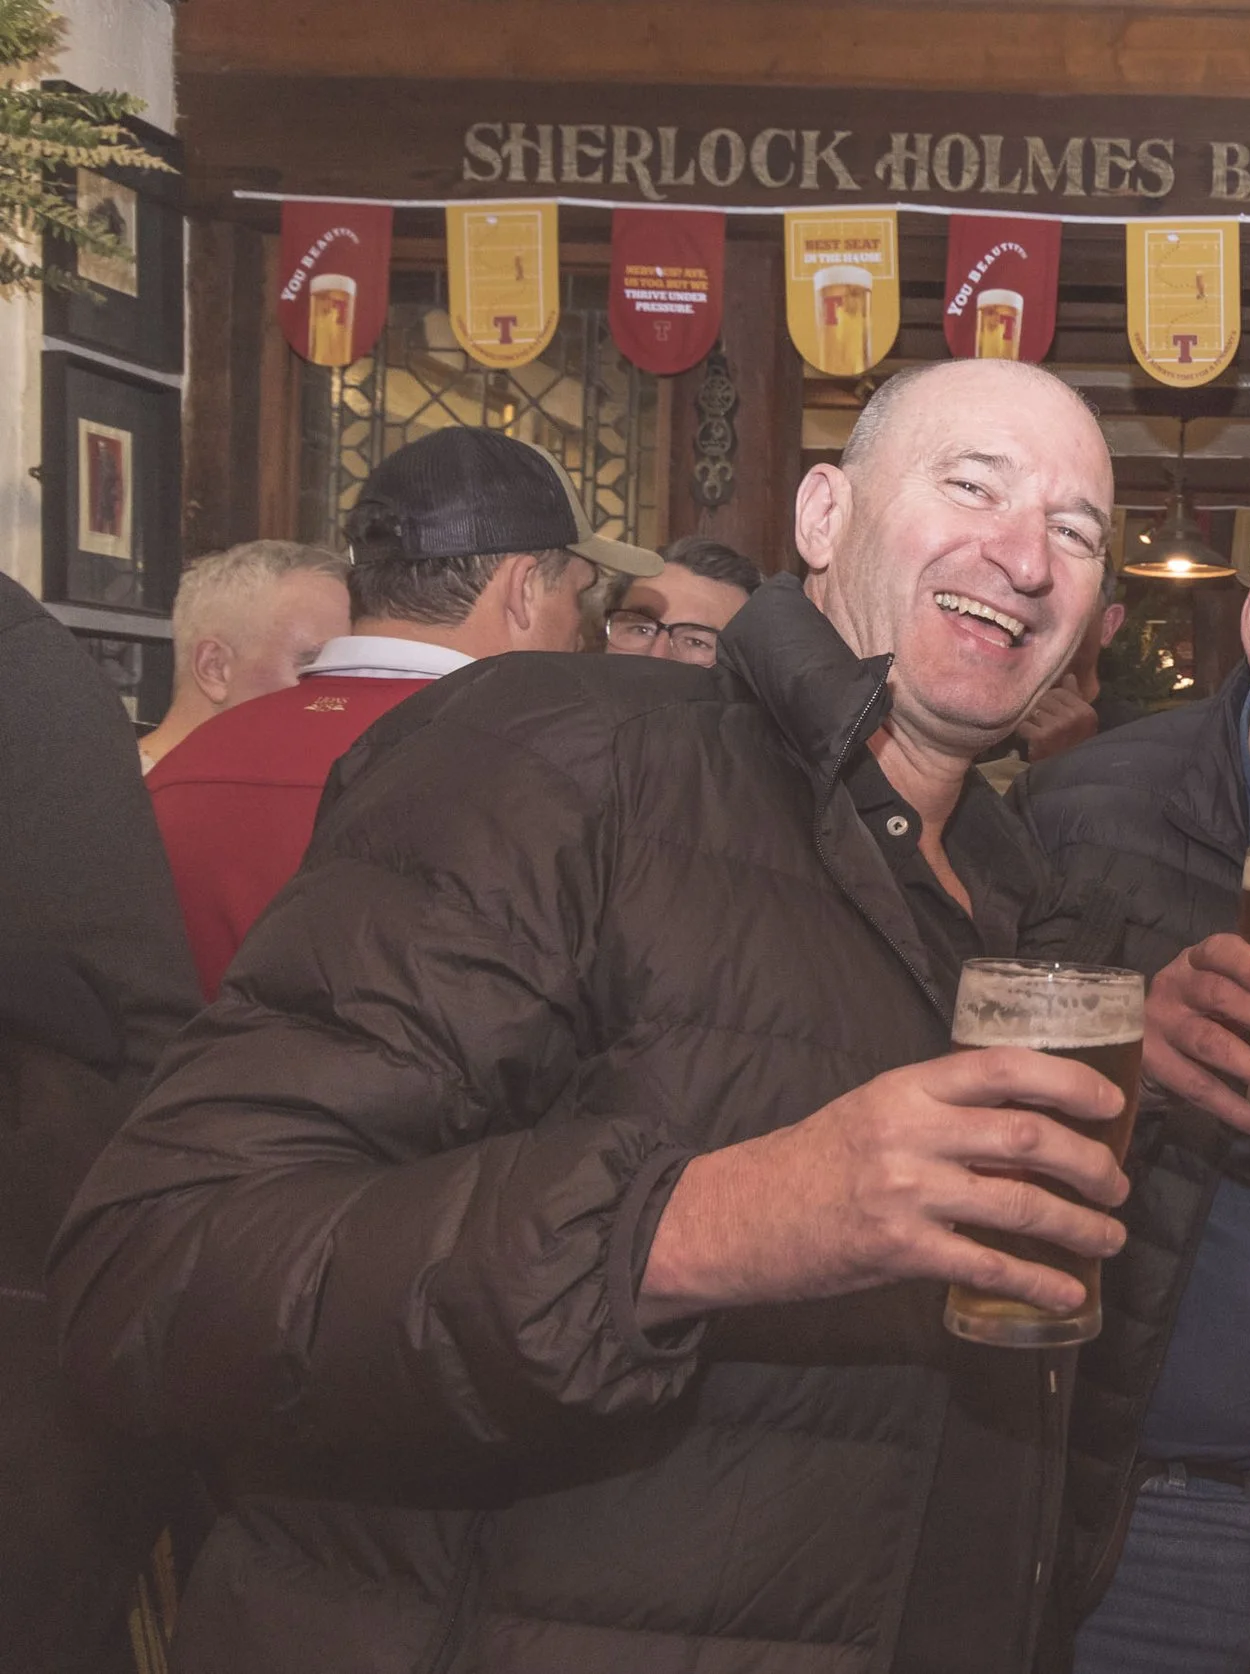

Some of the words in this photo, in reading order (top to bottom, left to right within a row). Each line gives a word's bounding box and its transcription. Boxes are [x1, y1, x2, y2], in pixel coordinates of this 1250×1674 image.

[462, 123, 862, 200] SHERLOCK
[875, 131, 1175, 198] HOLMES
[805, 239, 841, 251] BEST
[844, 238, 881, 251] SEAT
[281, 268, 307, 301] YOU
[624, 289, 668, 300] THRIVE
[668, 291, 707, 303] UNDER
[947, 283, 973, 316] YOU
[493, 316, 518, 345] T
[653, 320, 672, 341] T
[1172, 335, 1198, 363] T
